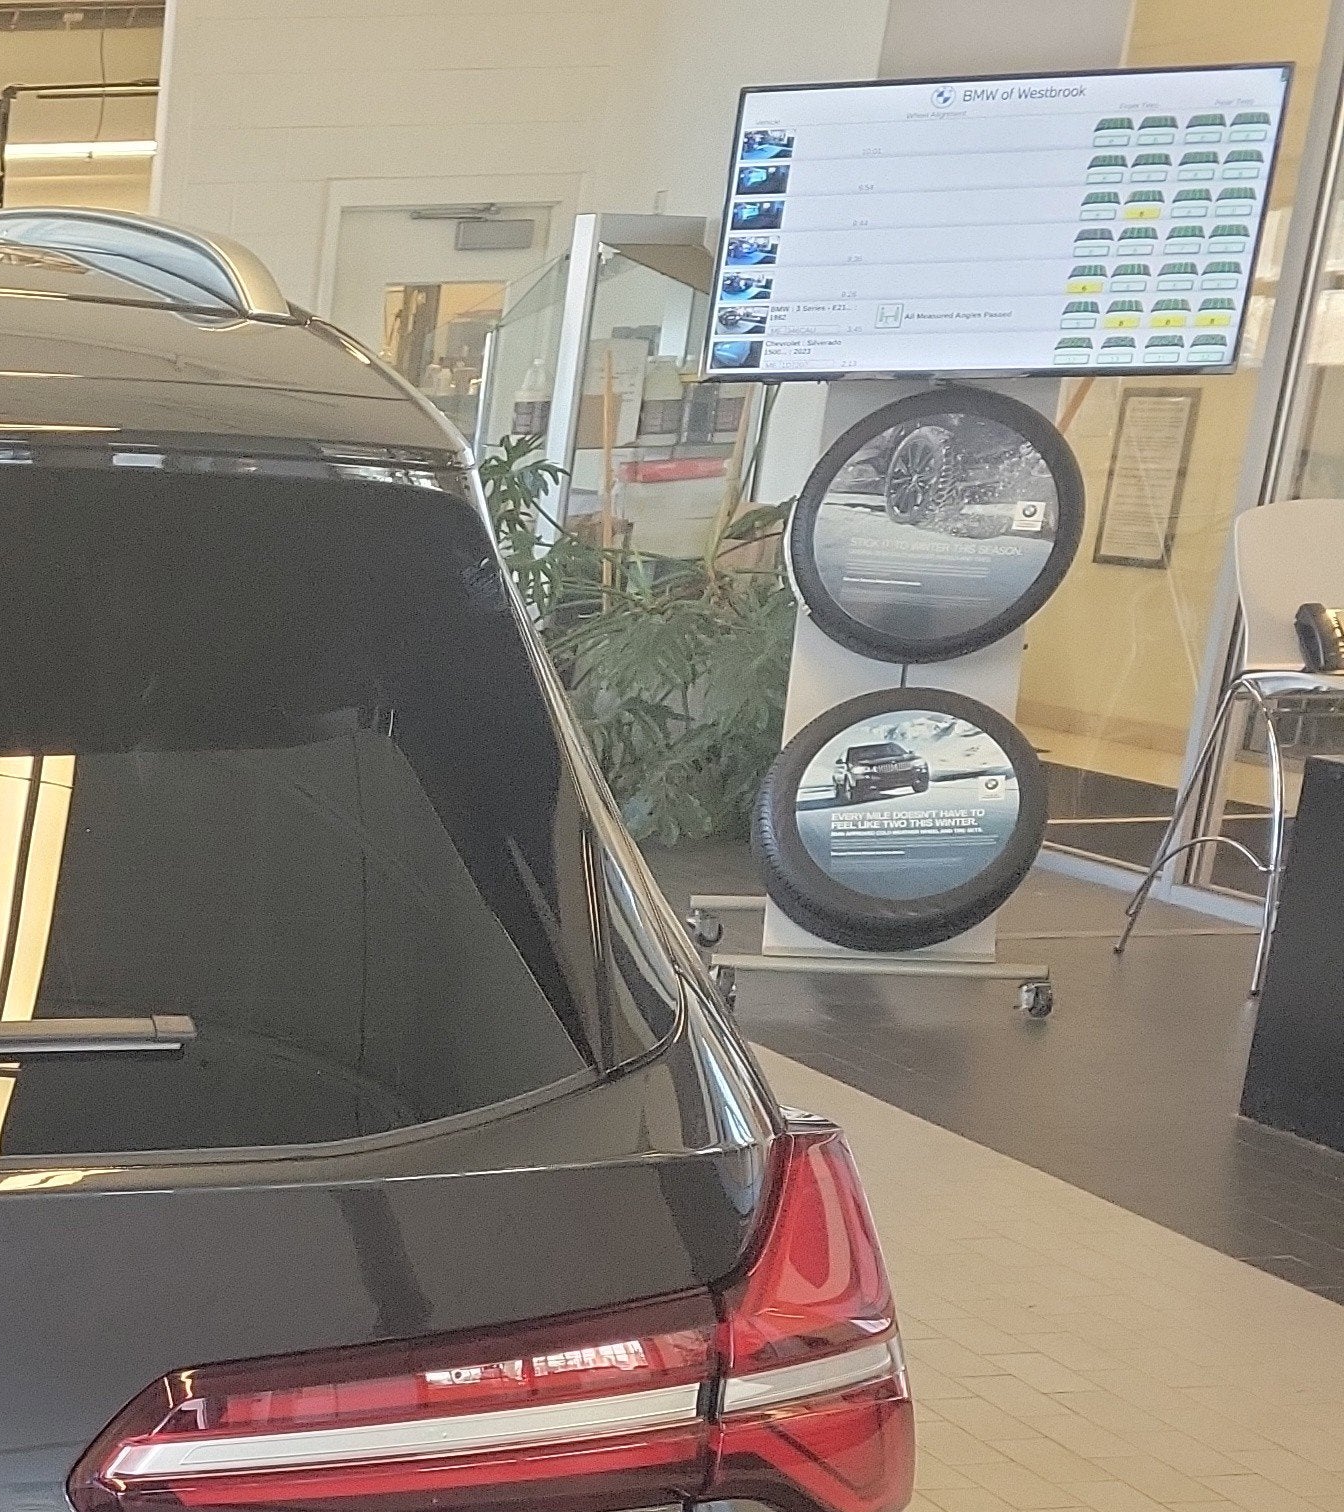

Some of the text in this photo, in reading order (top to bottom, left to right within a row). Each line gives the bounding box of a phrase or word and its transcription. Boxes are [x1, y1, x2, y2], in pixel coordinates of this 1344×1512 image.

[962, 84, 1087, 102] BMW of Westbrook
[806, 338, 842, 347] Silverado
[831, 808, 986, 821] EVERY MILE DOESN'T HAVE TO
[831, 818, 979, 830] FEEL LIKE TWO THIS WINTER.
